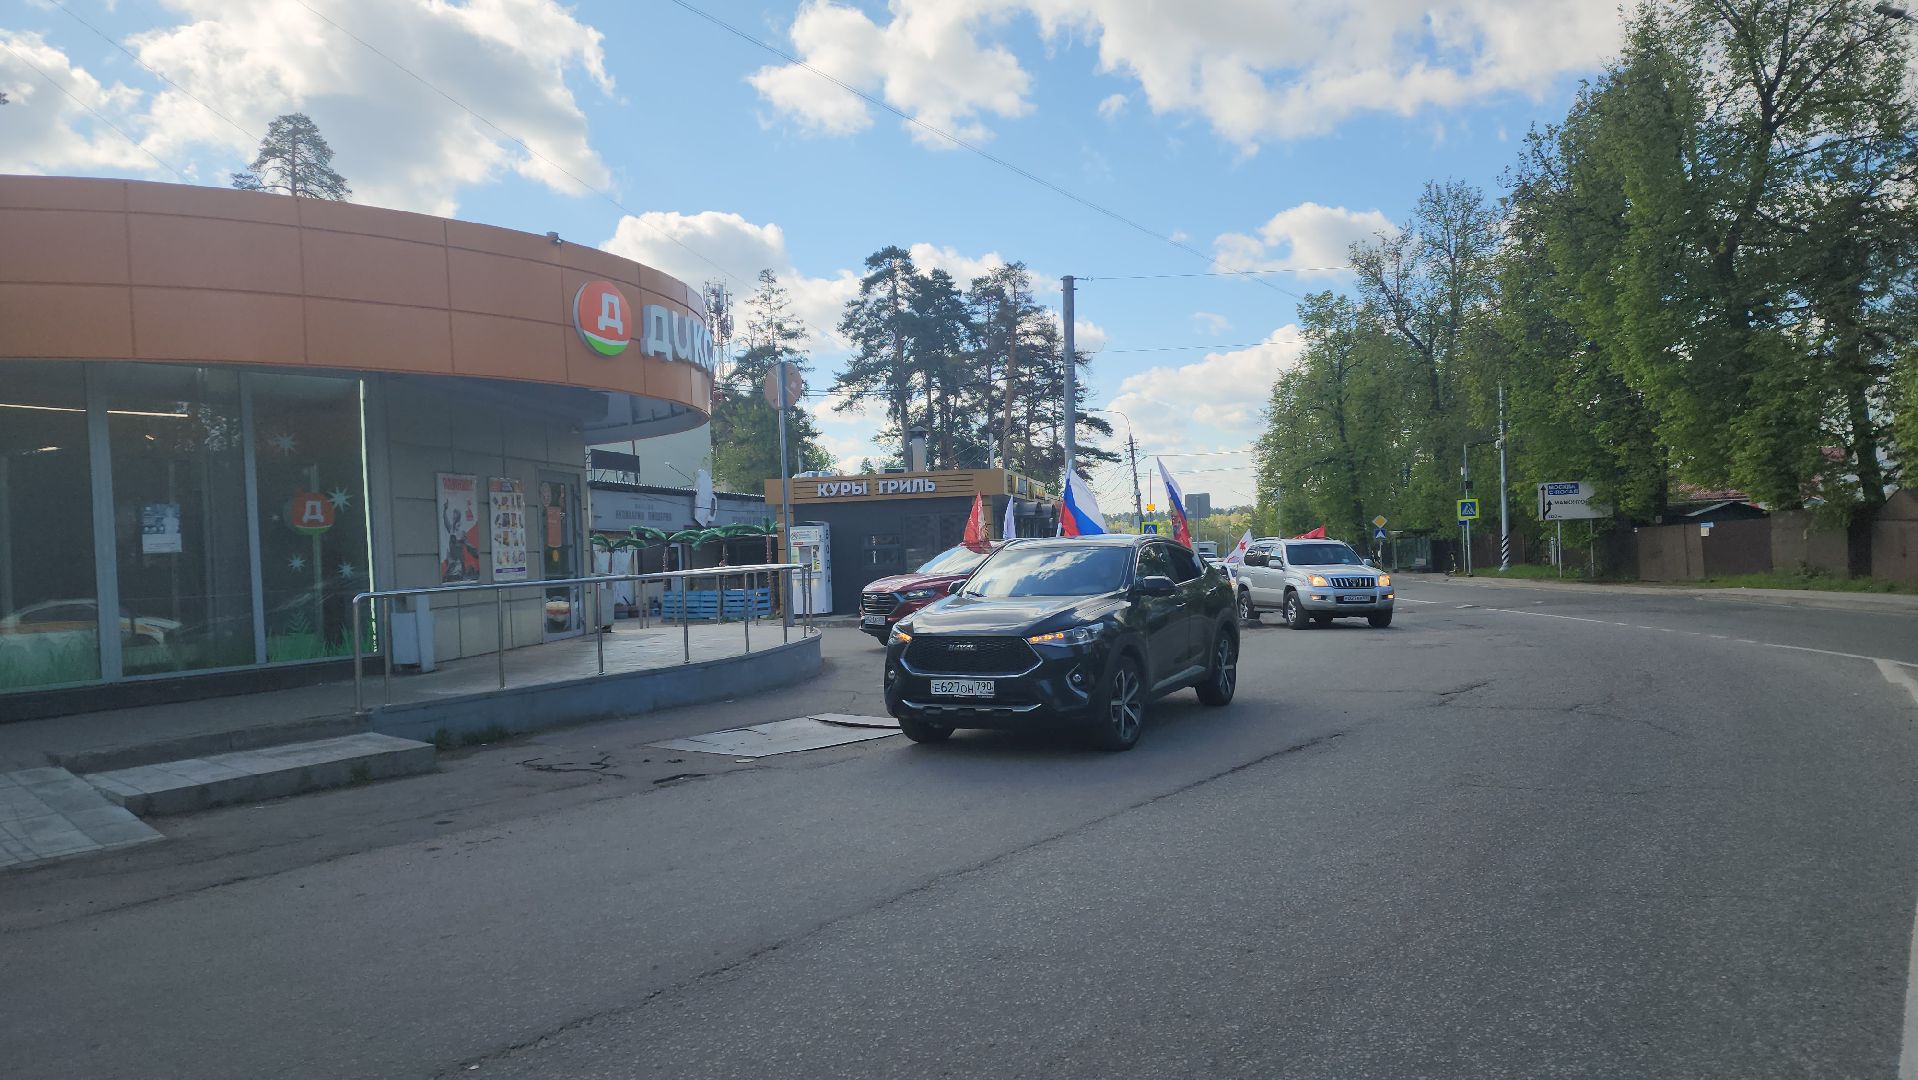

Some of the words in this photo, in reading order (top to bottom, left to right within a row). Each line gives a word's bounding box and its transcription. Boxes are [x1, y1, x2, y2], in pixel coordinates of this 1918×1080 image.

[597, 292, 623, 335] Д
[817, 480, 868, 497] КУРЫ
[878, 478, 937, 494] ГРИЛЬ
[303, 500, 325, 523] Д
[934, 681, 974, 693] Е627ОН
[975, 681, 992, 691] 790
